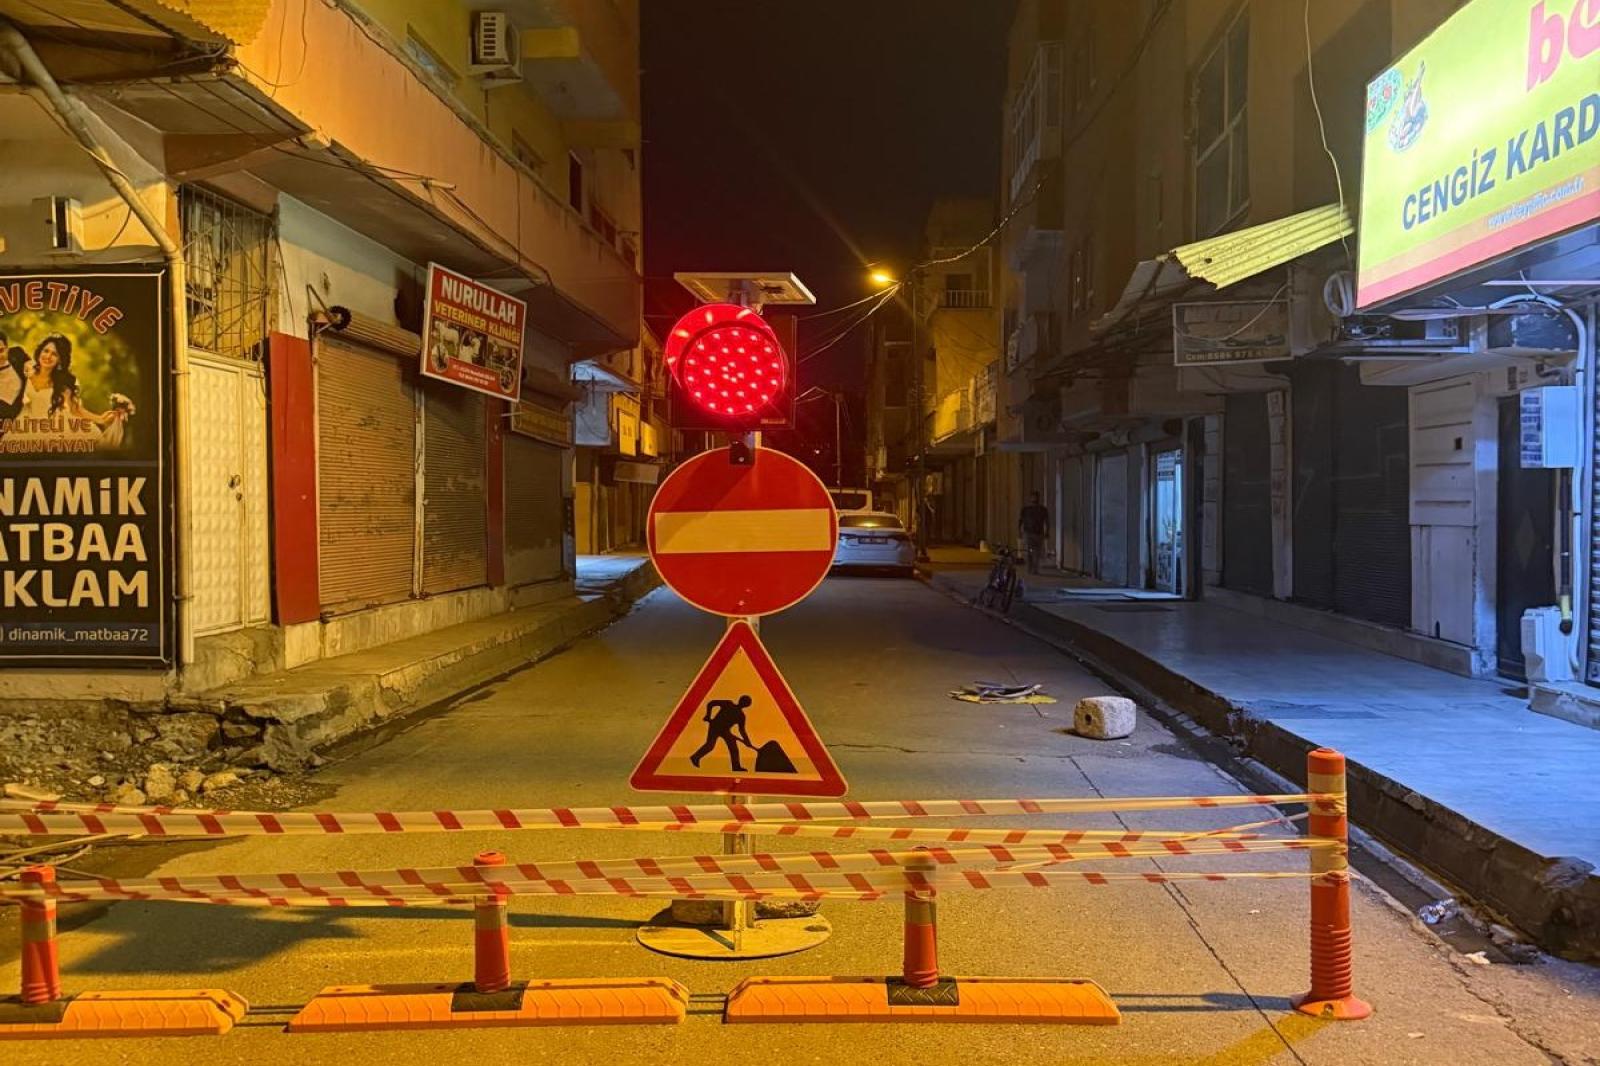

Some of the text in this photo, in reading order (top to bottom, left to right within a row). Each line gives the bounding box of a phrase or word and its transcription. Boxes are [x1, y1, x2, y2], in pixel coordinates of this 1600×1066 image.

[1402, 93, 1600, 230] CENGİZ KARD
[434, 300, 487, 333] VETERİNER
[441, 275, 517, 326] NURULLAH
[68, 418, 92, 433] VE
[0, 522, 148, 562] TBAA
[8, 627, 149, 643] dinamik_matbaa72
